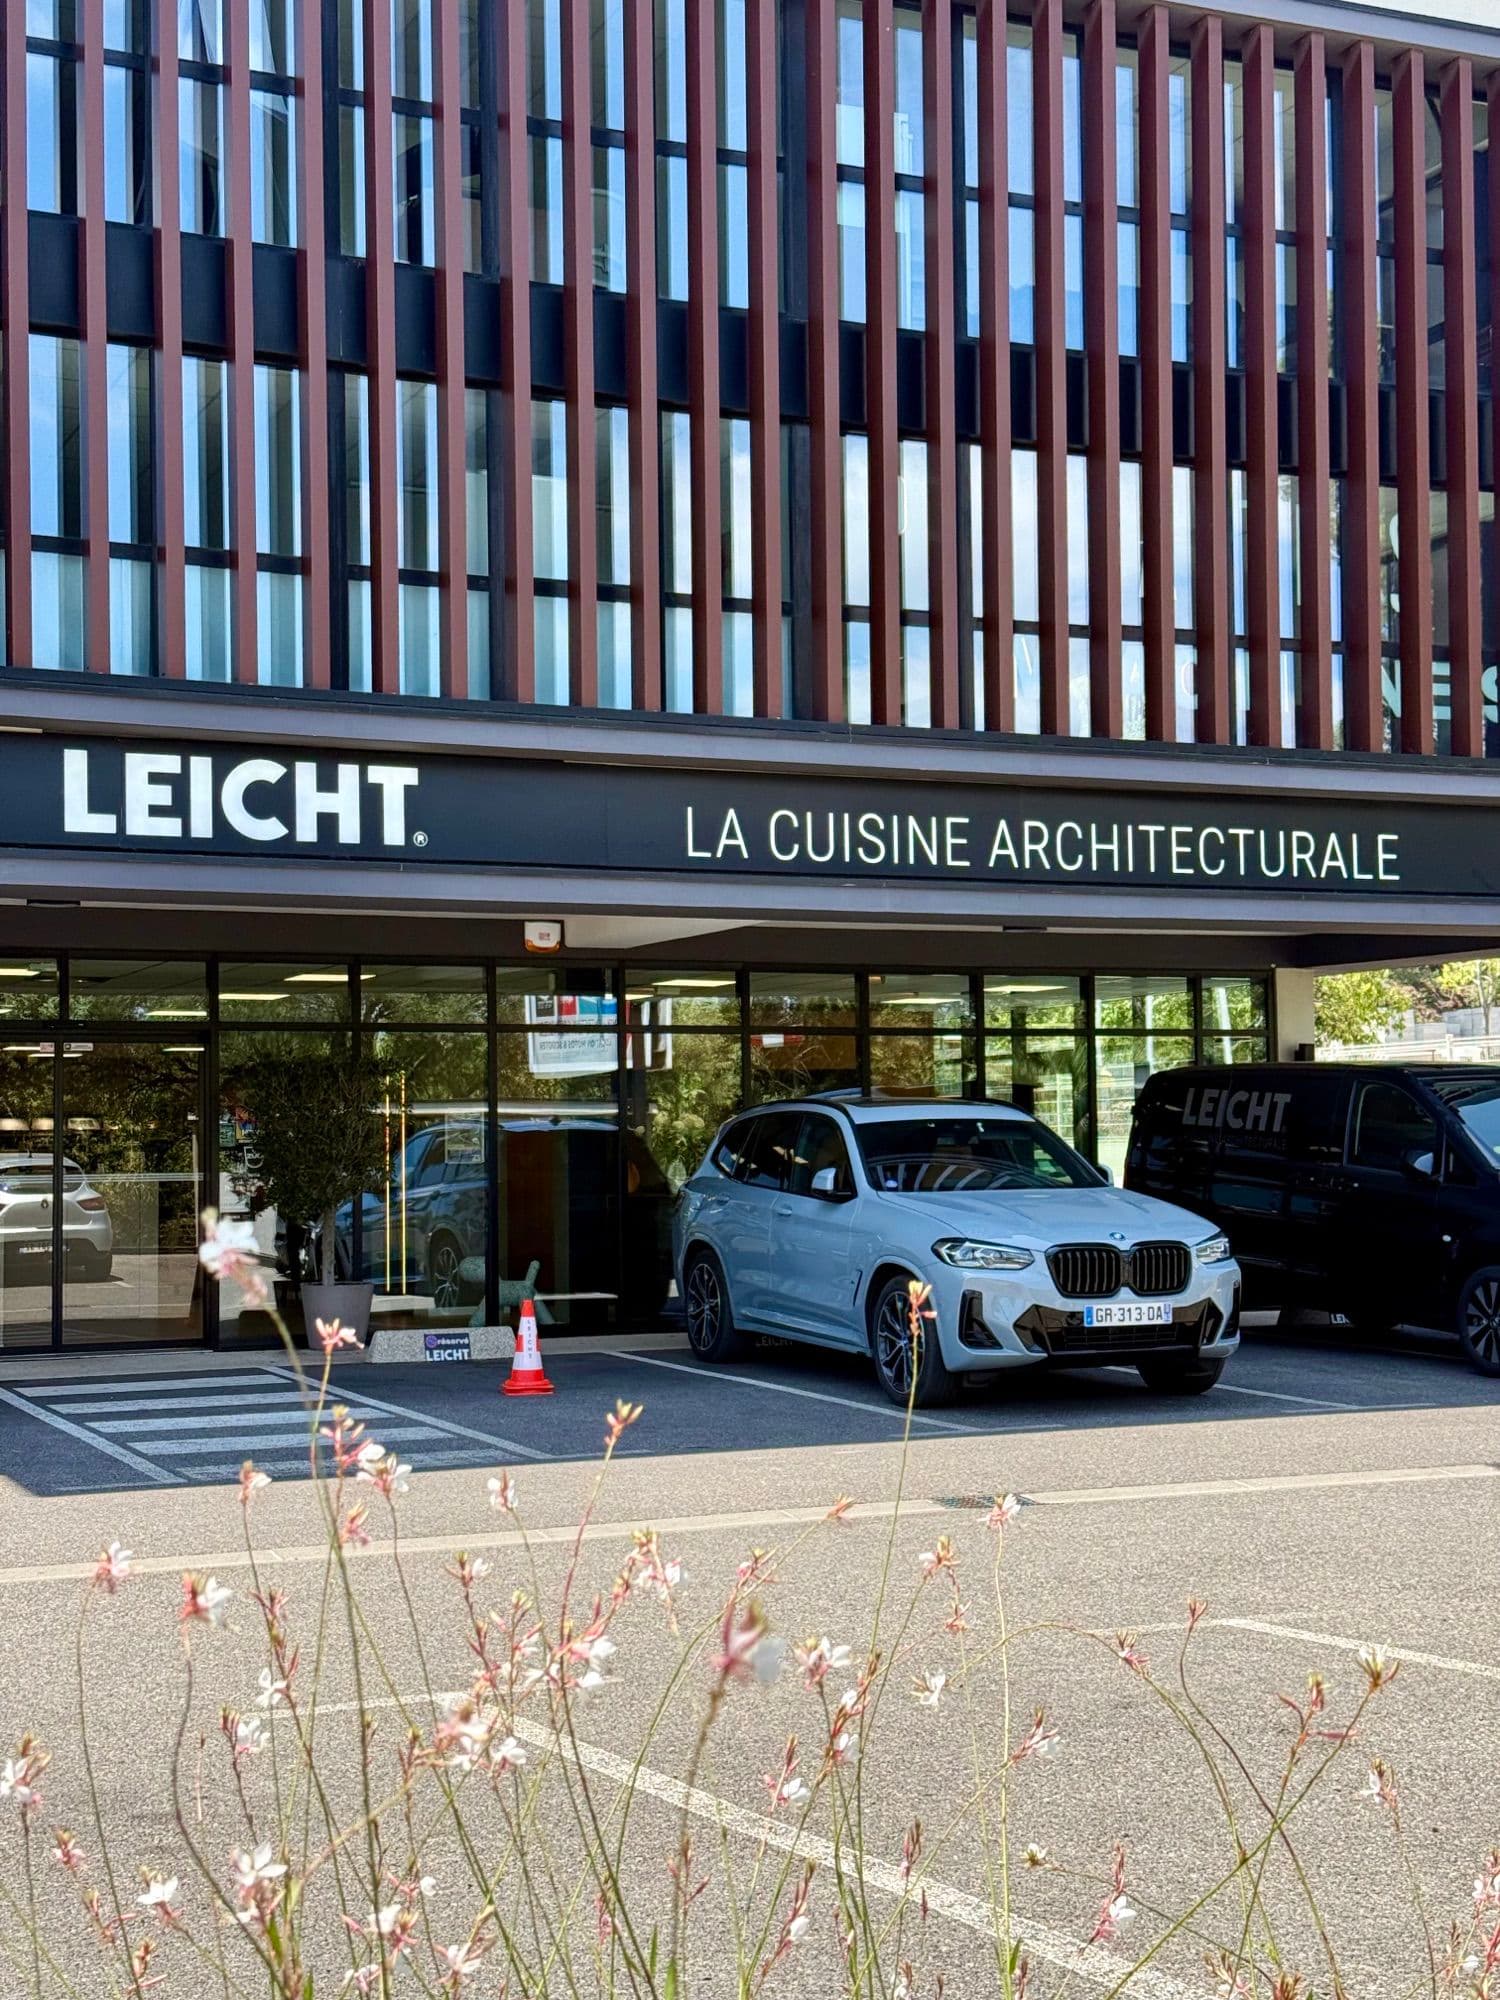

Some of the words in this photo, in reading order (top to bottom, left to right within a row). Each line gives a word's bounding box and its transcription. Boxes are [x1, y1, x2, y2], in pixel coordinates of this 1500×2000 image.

[686, 806, 749, 860] LA
[768, 809, 971, 867] CUISINE
[988, 819, 1401, 882] ARCHITECTURALE
[1181, 1087, 1293, 1133] LEICHT
[425, 1348, 469, 1361] LEICHT
